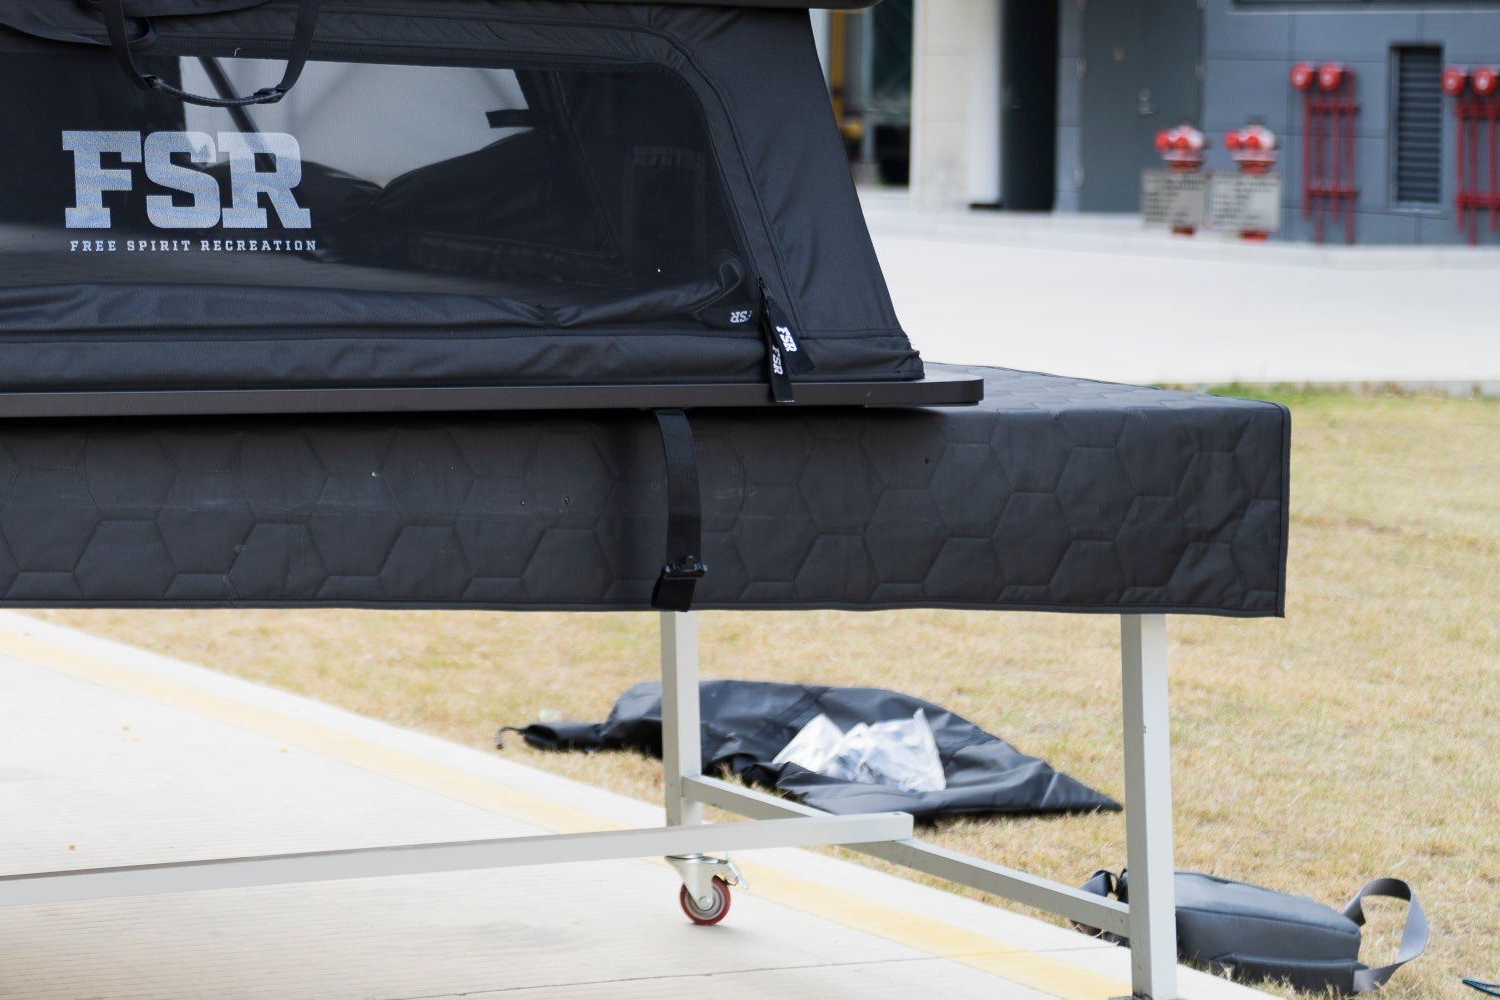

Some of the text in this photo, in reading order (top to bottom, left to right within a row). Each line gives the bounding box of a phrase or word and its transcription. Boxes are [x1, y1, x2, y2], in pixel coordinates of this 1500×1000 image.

[61, 130, 312, 229] FSR
[70, 239, 317, 252] FREE SPIRIT RECREATION
[775, 326, 798, 352] FSR
[772, 345, 784, 375] FSR
